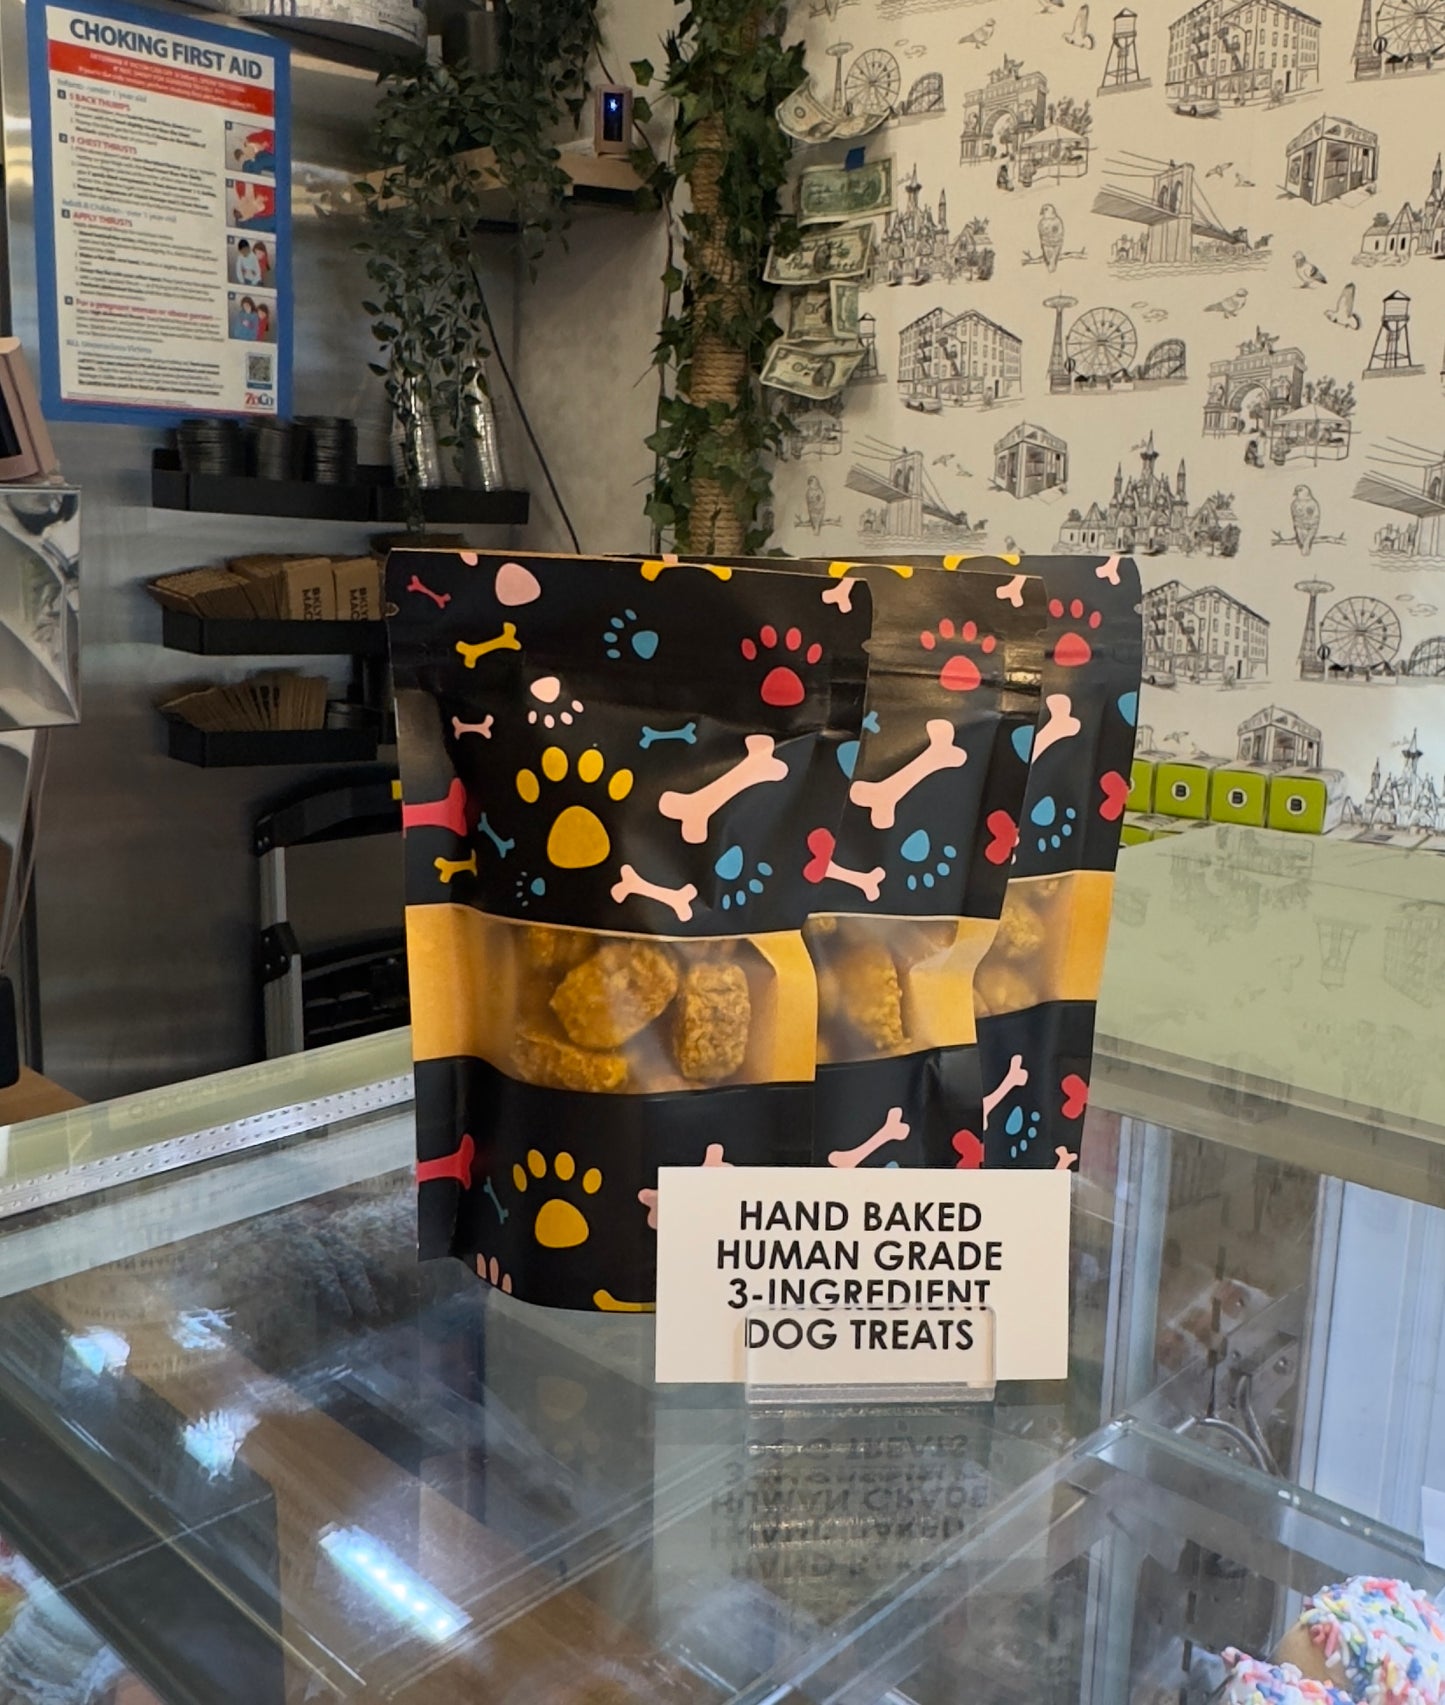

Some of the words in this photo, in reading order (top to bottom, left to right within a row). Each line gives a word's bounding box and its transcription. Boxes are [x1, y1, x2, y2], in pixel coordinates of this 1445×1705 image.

[69, 18, 168, 58] CHOKING
[173, 41, 225, 72] FIRST
[229, 56, 262, 80] AID
[313, 587, 321, 621] BKLY
[360, 587, 368, 621] BKLY
[741, 1201, 848, 1231] HAND
[864, 1202, 982, 1232] BAKED
[717, 1240, 859, 1270] HUMAN
[874, 1241, 1003, 1271] GRADE
[727, 1278, 991, 1311] 3-INGREDIENT
[744, 1319, 838, 1350] DOG
[849, 1320, 974, 1351] TREATS
